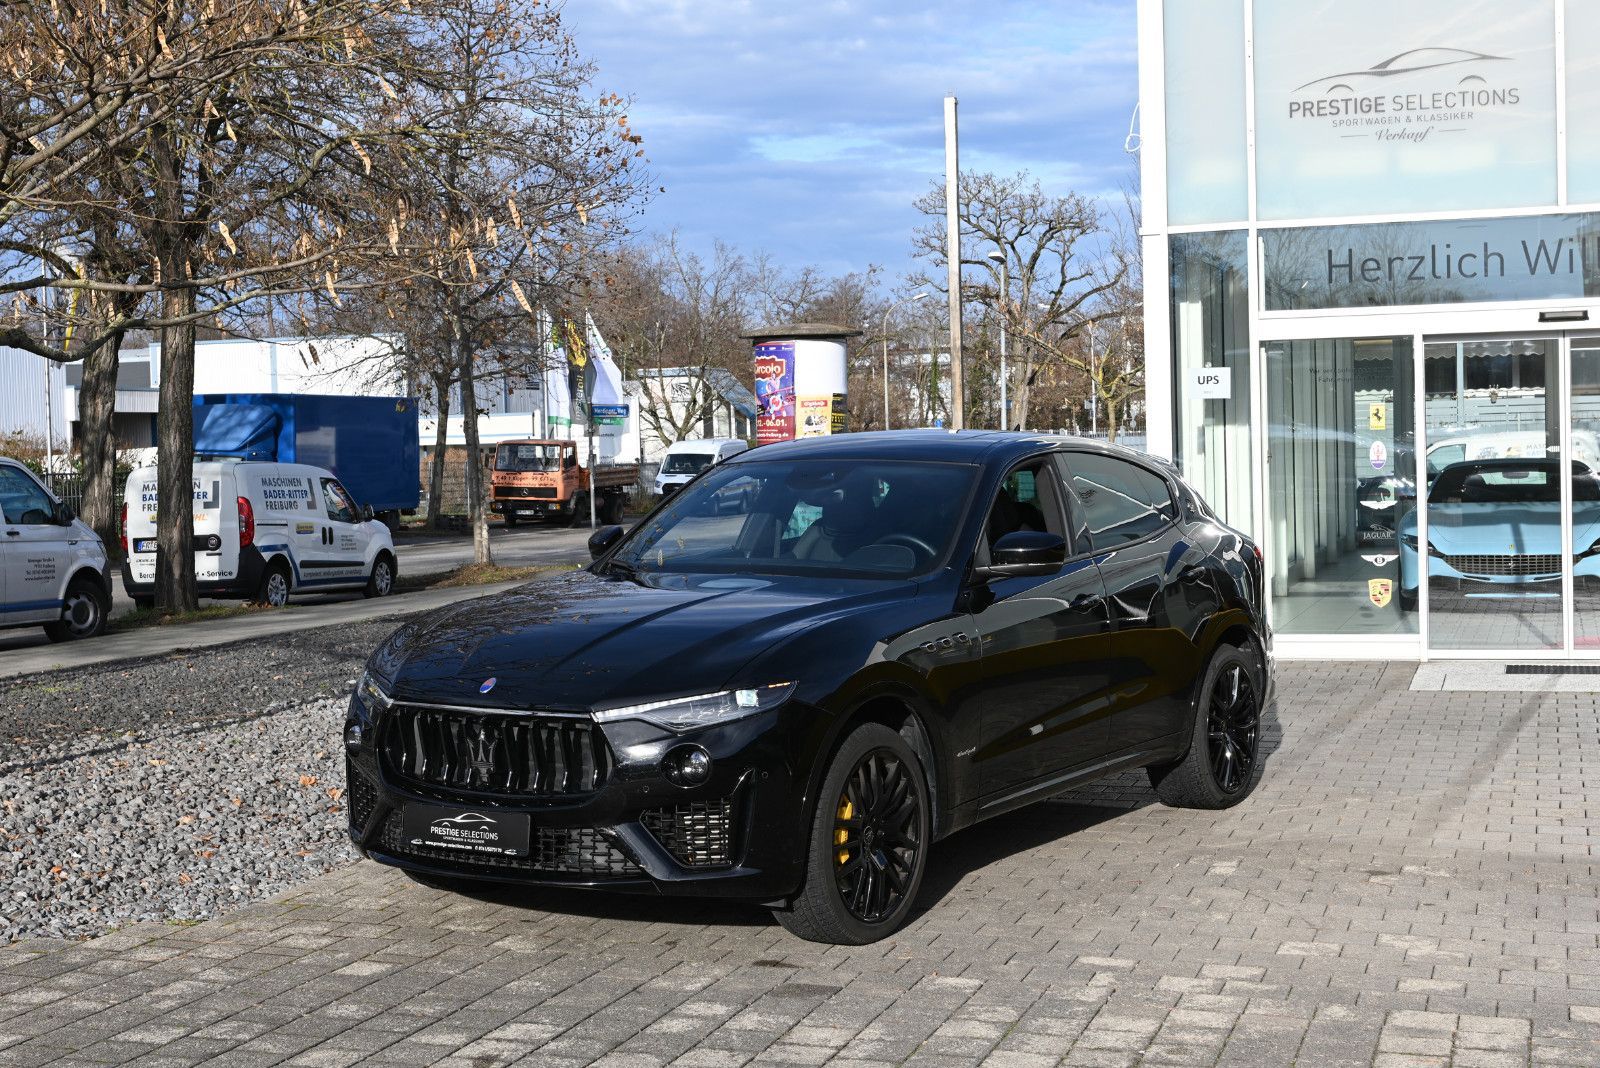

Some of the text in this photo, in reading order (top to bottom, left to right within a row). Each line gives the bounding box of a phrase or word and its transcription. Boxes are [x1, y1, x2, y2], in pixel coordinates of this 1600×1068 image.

[1289, 88, 1520, 118] PRESTIGE SELECTIONS
[1332, 111, 1474, 128] SPORTWAGEN & KLASSIKER
[1375, 126, 1435, 143] Verkauf
[1327, 242, 1505, 284] Herzlich
[1197, 375, 1219, 385] UPS
[261, 477, 302, 487] MASCHINEN
[263, 489, 308, 499] BADER-RITTER
[265, 500, 299, 510] FREIBURG
[1363, 531, 1392, 540] JAGUAR
[430, 826, 460, 837] PRESTIGE
[460, 830, 499, 841] SELECTIONS
